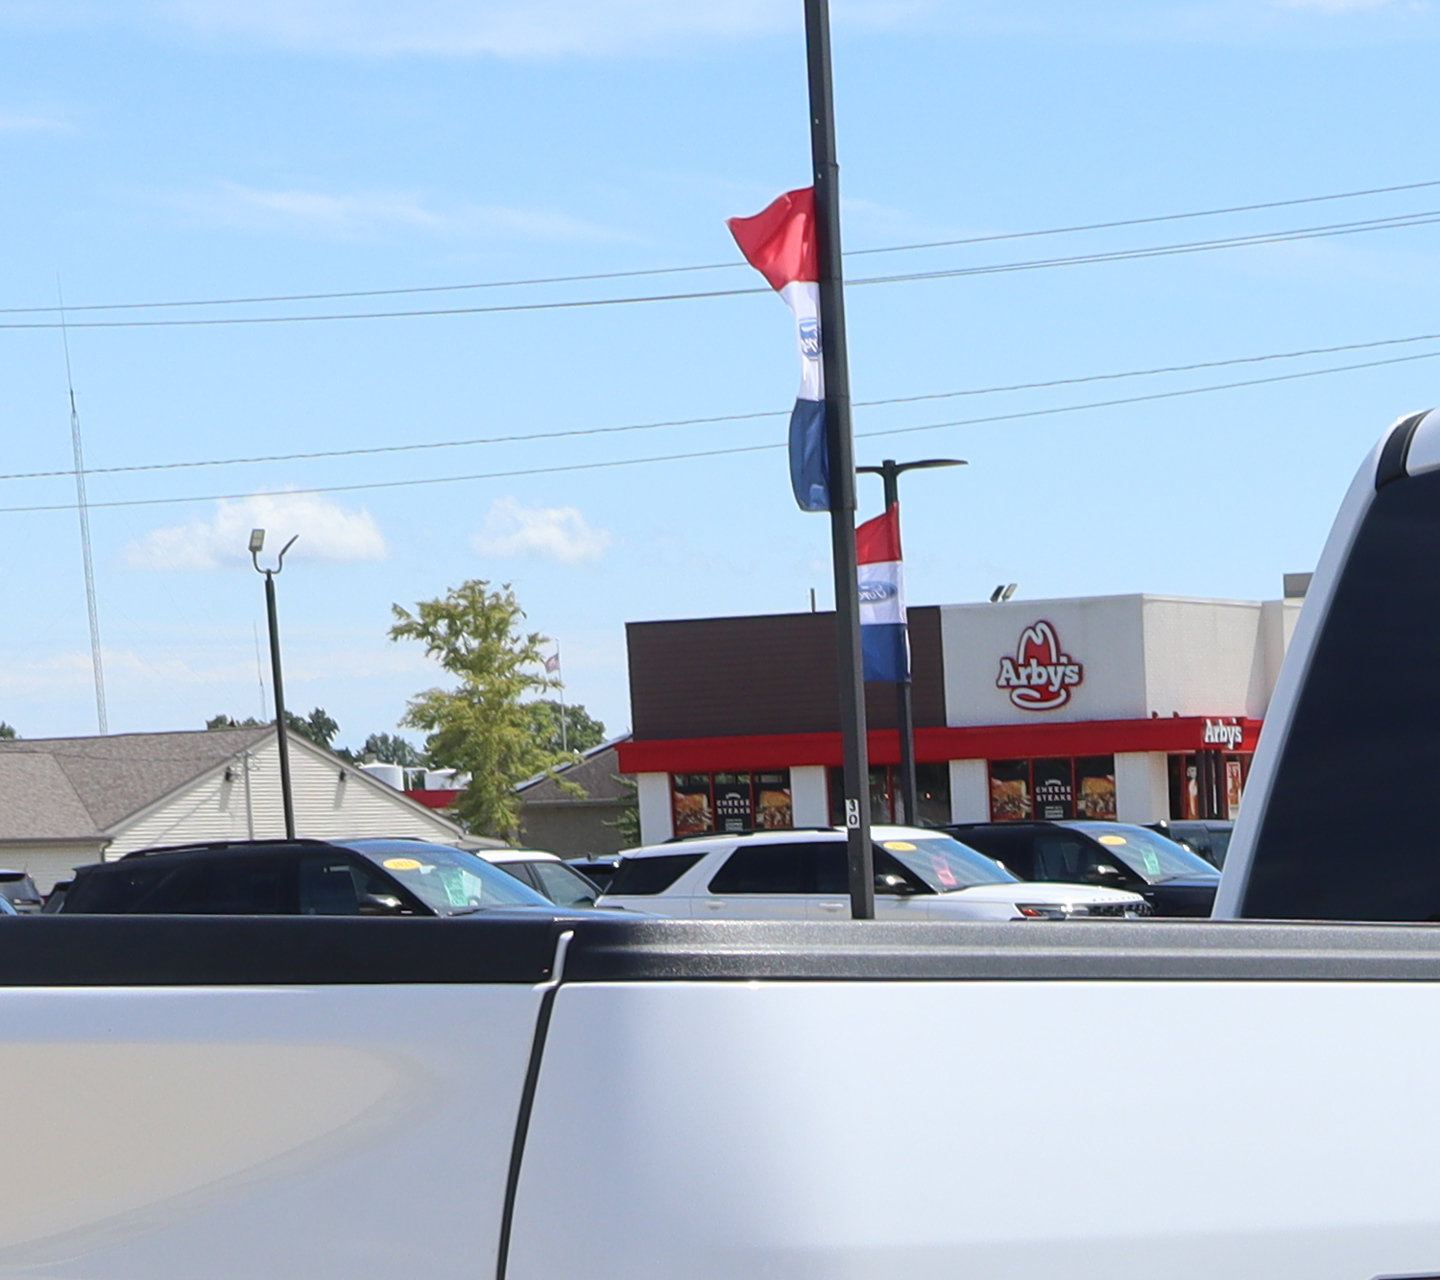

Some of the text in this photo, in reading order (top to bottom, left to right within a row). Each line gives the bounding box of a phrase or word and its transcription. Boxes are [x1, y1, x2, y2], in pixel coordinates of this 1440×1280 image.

[997, 656, 1080, 692] Arby's
[1204, 717, 1243, 750] Arby's
[1036, 794, 1072, 802] STEAKS
[717, 807, 751, 815] STEAKS
